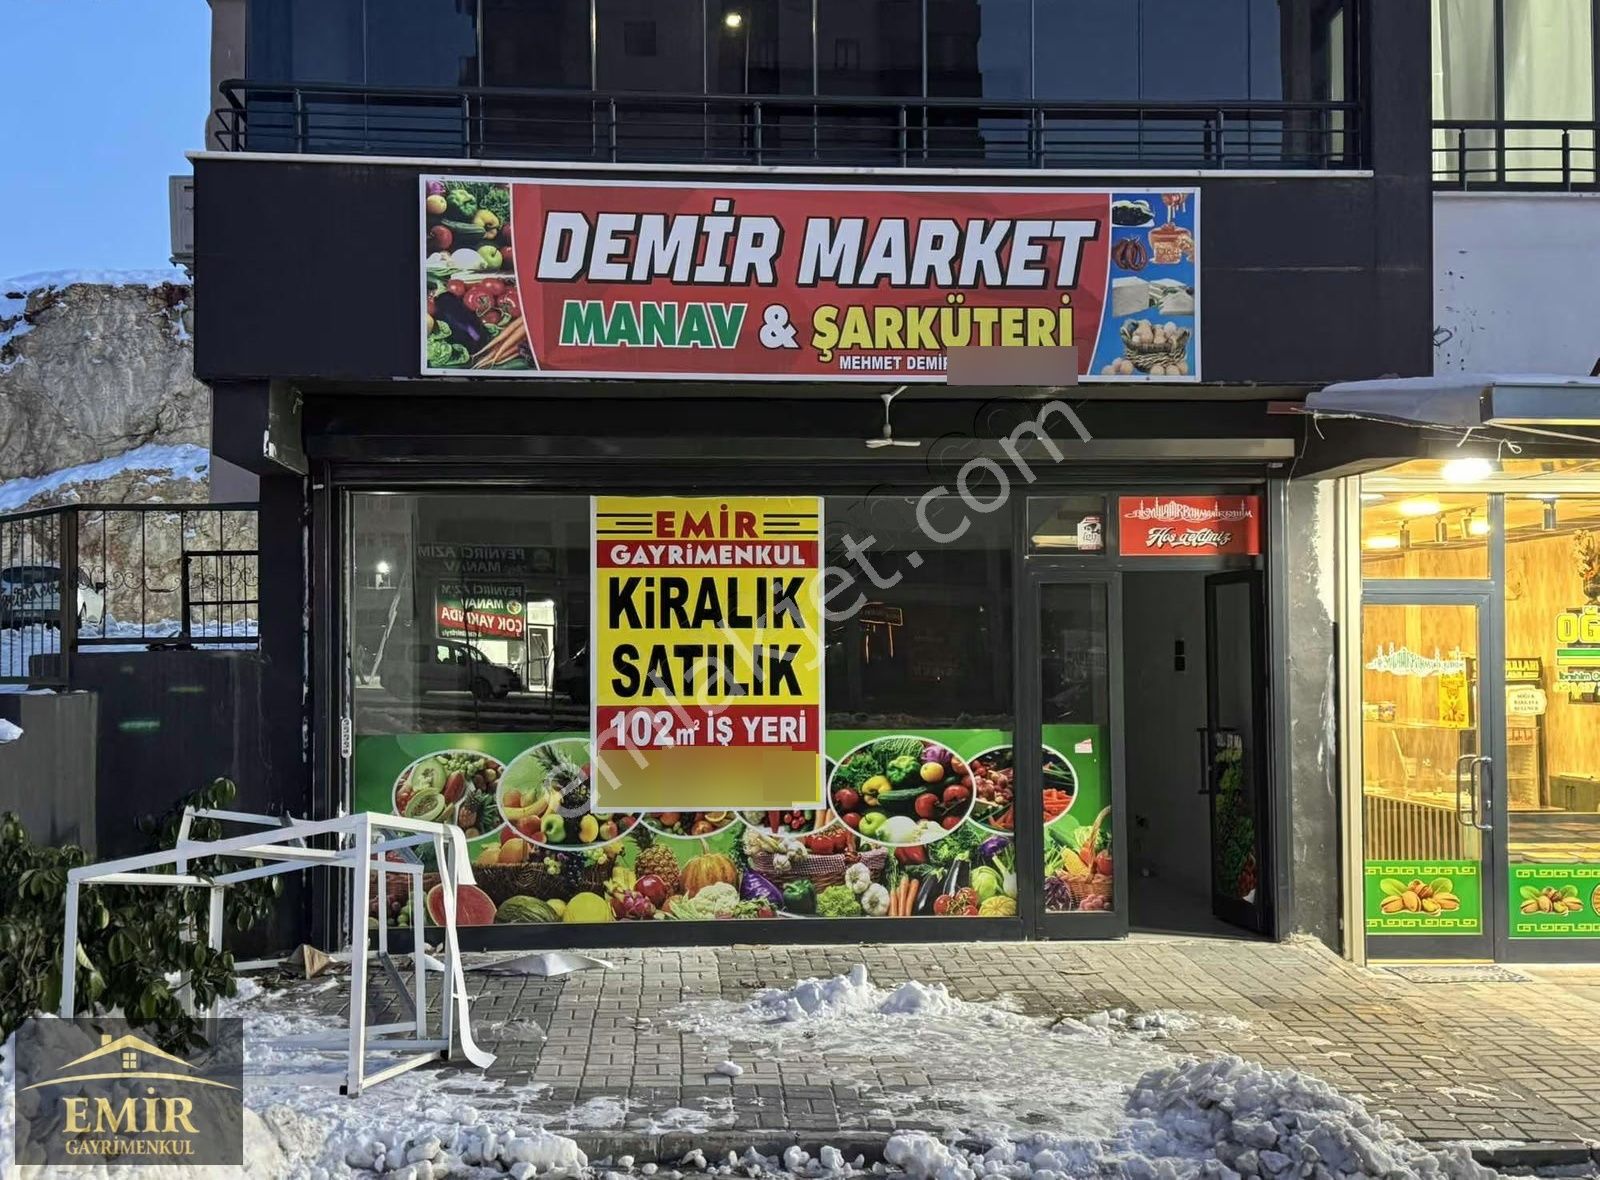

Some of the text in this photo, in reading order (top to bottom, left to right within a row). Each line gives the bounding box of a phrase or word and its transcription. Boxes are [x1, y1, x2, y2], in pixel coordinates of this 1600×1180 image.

[535, 197, 1101, 288] DEMİR MARKET
[558, 293, 1074, 362] MANAV & ŞARKÜTERİ
[840, 355, 901, 370] MEHMET
[656, 504, 760, 538] EMİR
[611, 644, 803, 697] SATILIK
[707, 710, 733, 746] İŞ
[741, 710, 806, 743] YERİ
